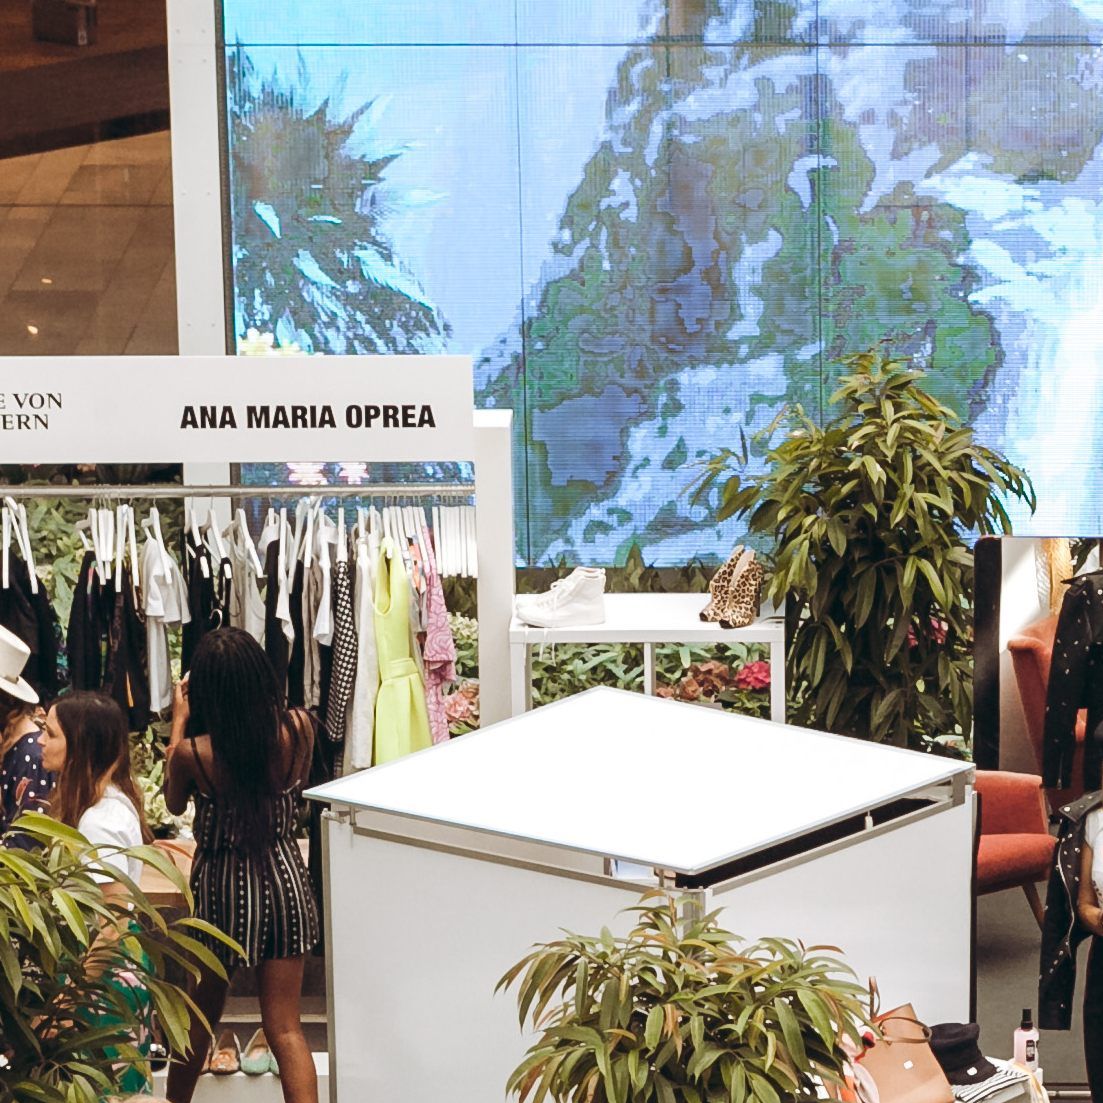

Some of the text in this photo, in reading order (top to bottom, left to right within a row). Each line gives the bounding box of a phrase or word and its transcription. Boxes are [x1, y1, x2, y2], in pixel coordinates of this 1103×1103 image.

[12, 392, 63, 410] VON
[179, 404, 437, 429] ANA MARIA OPREA
